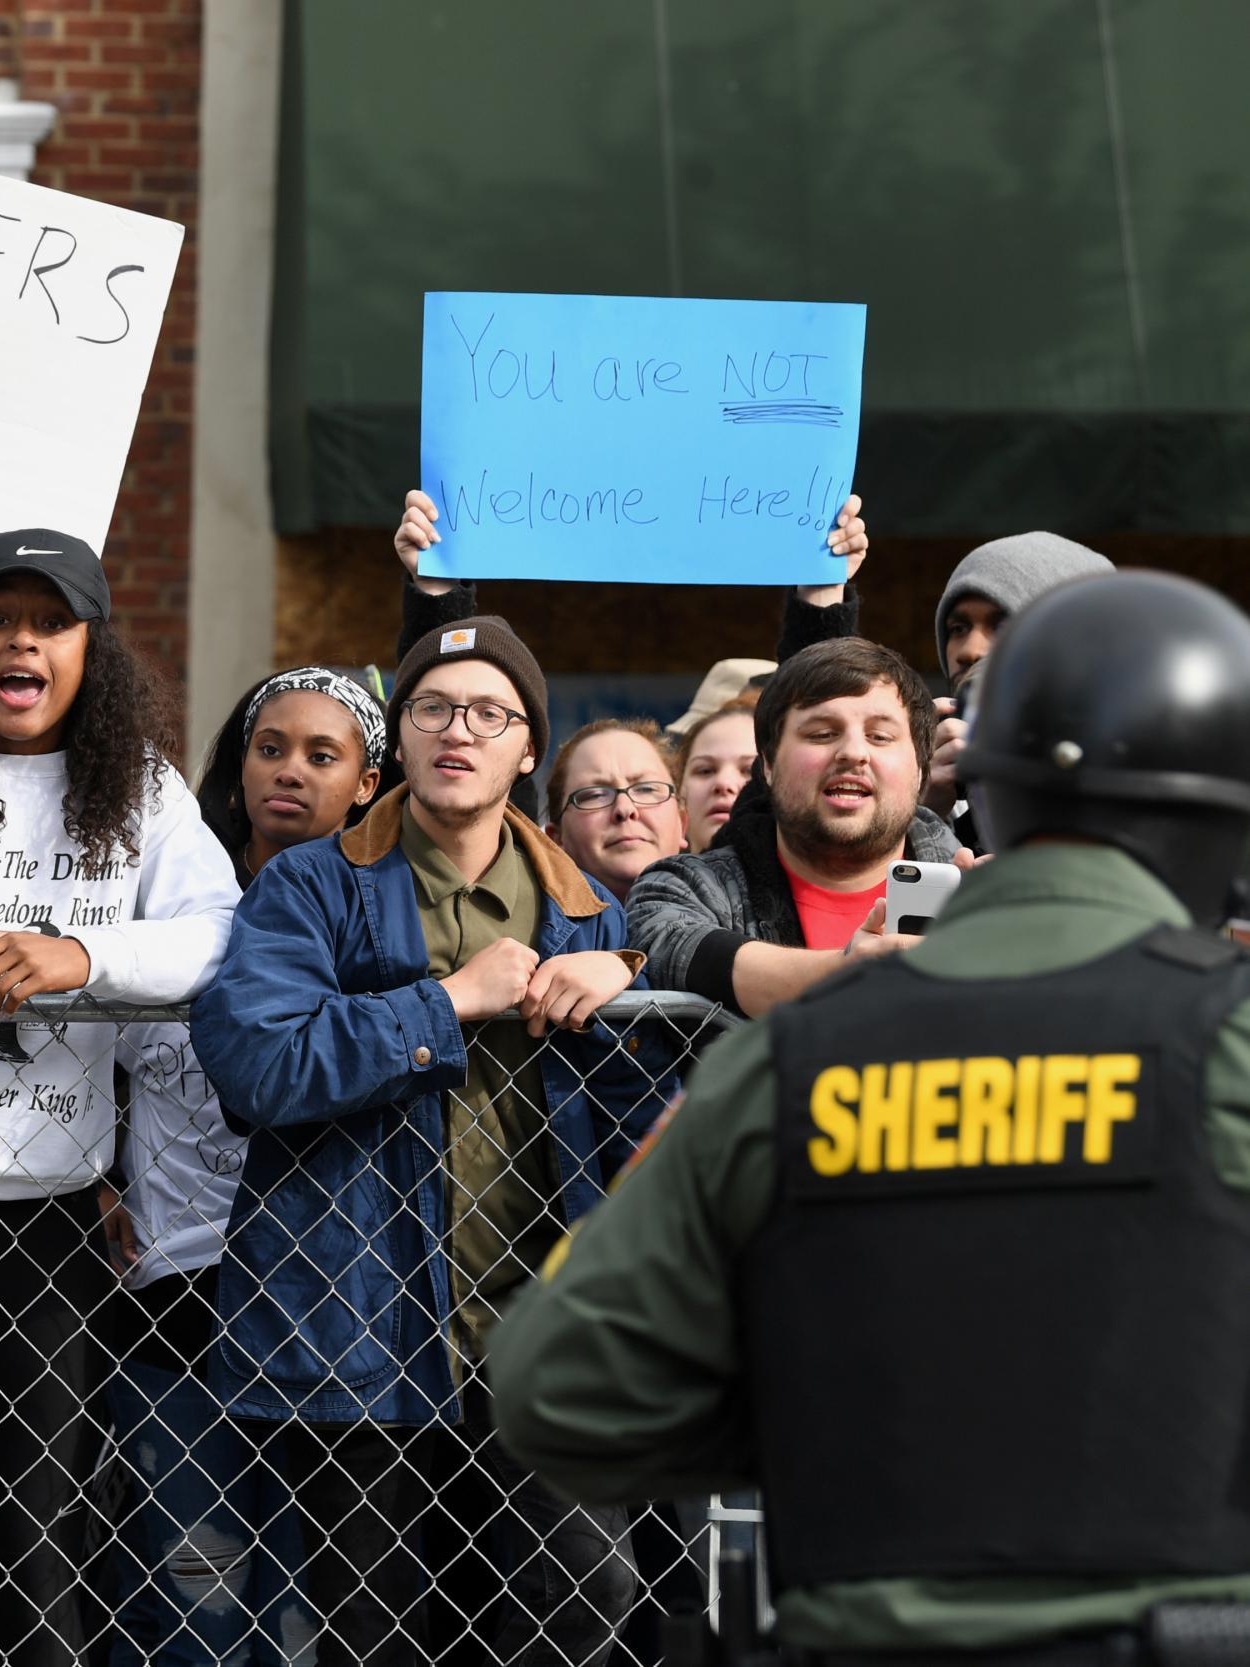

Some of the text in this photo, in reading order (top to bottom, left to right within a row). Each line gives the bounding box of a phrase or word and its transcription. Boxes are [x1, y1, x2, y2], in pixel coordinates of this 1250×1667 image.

[450, 312, 829, 402] You are NOT
[441, 469, 659, 532] Welcome
[3, 849, 39, 881] The
[51, 852, 126, 881] Drm:
[67, 897, 122, 927] Ring!
[28, 1083, 78, 1123] King,
[808, 1053, 1142, 1178] SHERIFF
